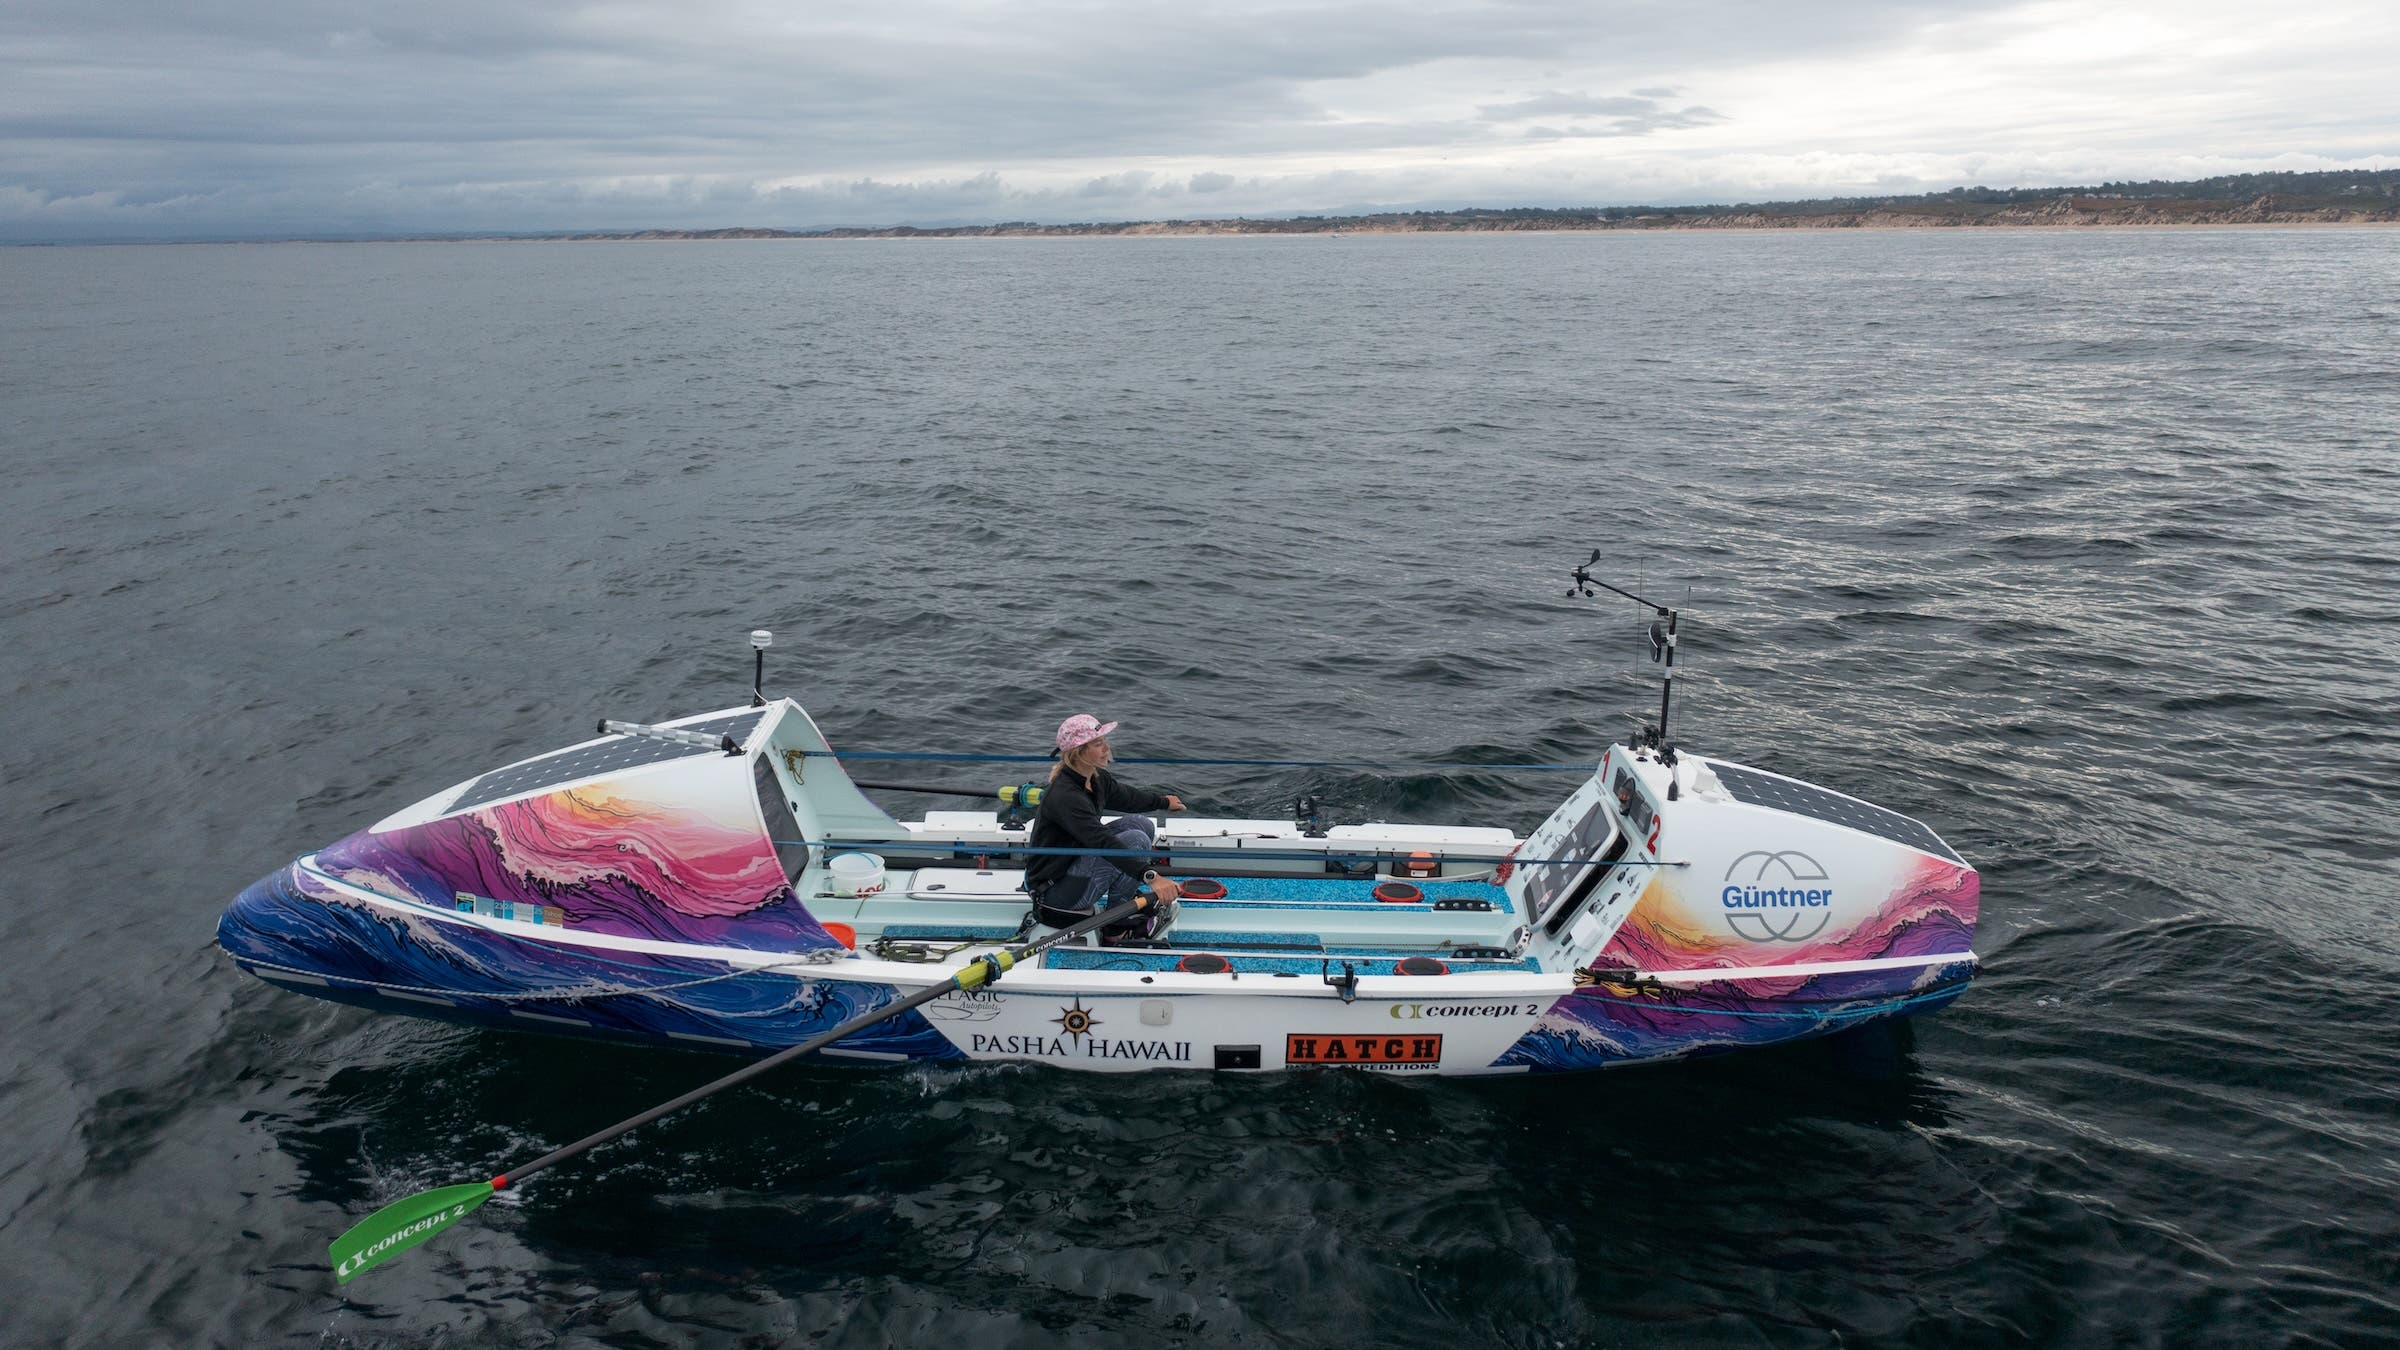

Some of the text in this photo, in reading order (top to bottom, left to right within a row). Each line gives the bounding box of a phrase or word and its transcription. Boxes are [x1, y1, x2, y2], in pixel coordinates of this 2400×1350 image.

[1602, 749, 1611, 784] 1
[1646, 814, 1661, 856] 2
[1722, 885, 1832, 908] Güntner
[1426, 1004, 1519, 1018] concept
[1526, 1004, 1539, 1016] 2
[971, 1034, 1191, 1061] PASHA HAWAII
[1292, 1039, 1436, 1058] HATCH
[367, 1211, 449, 1258] concept
[453, 1204, 465, 1217] 2
